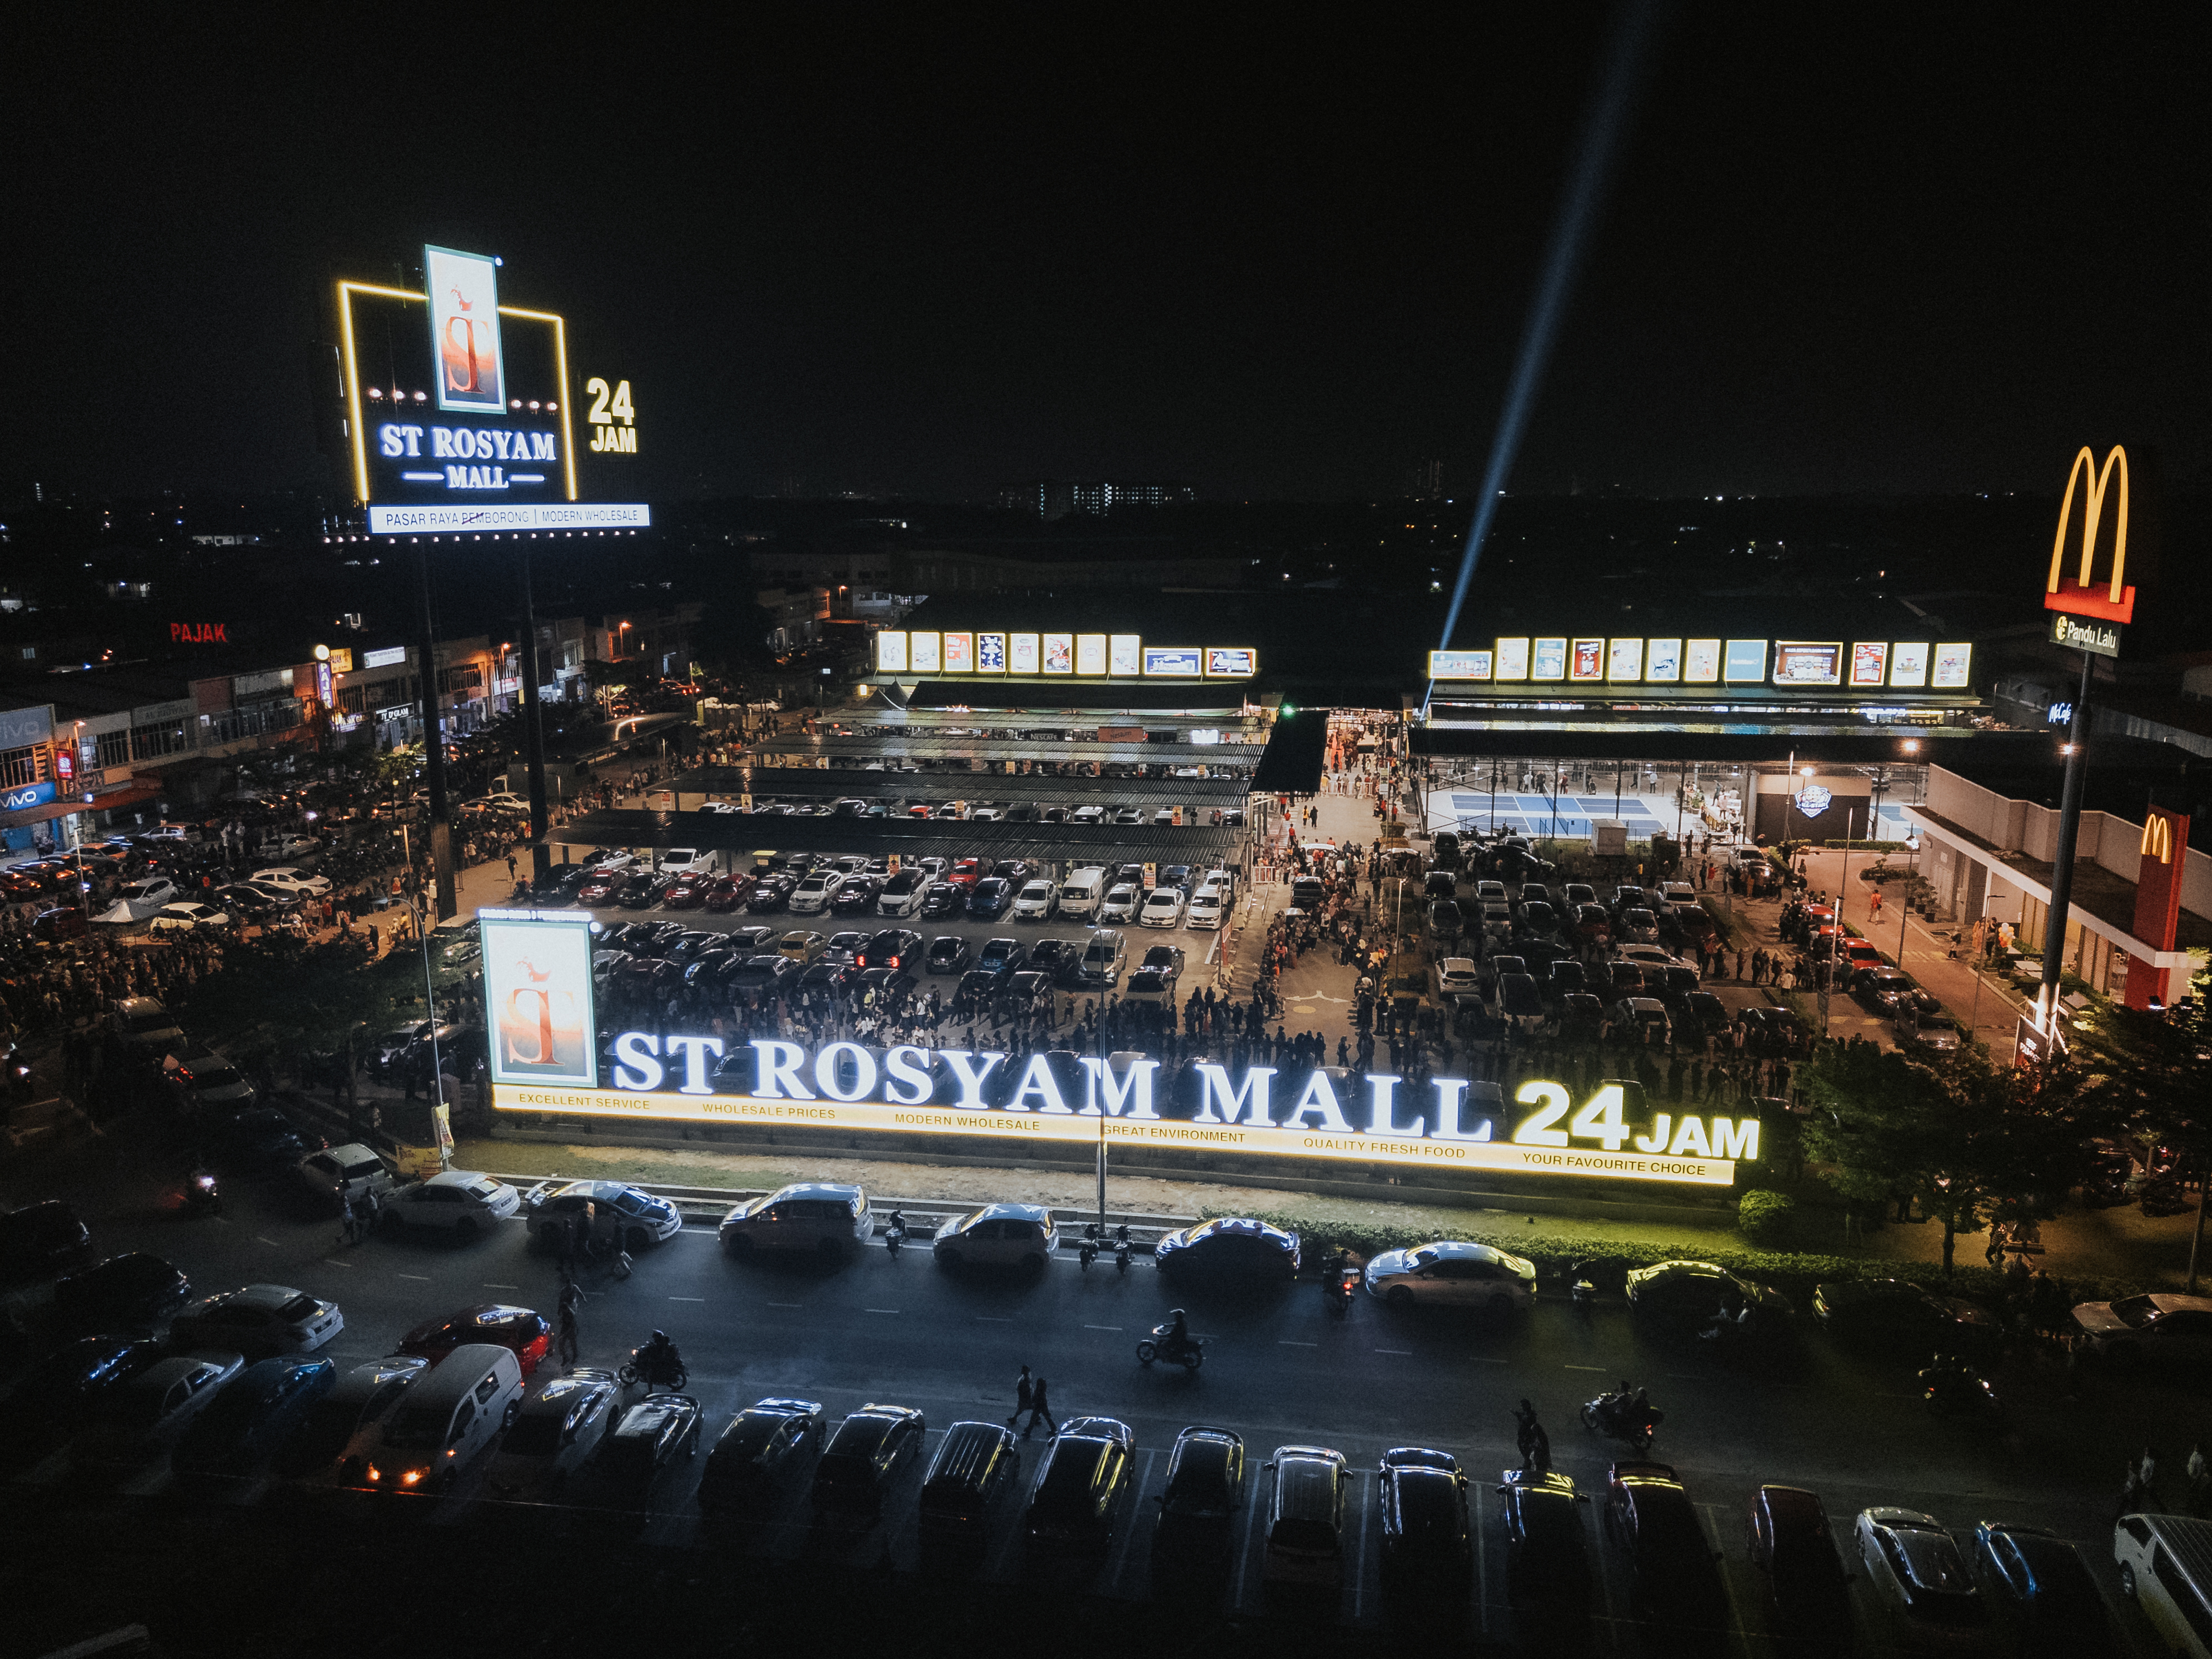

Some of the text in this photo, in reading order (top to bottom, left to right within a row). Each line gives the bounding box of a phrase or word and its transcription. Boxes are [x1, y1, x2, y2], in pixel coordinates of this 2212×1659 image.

[587, 377, 635, 425] 24
[381, 425, 556, 460] ST ROSYAM
[590, 426, 637, 453] JAM
[446, 466, 509, 489] MALL
[386, 509, 637, 526] PASAR RAYA PEMBORONG MODERN WHOLESALE
[171, 622, 227, 643] PAJAK
[2067, 621, 2116, 649] Pandu Lalu
[320, 662, 332, 709] PAJAK
[2049, 703, 2071, 725] McCafé
[0, 790, 37, 808] vivo
[519, 1093, 650, 1109] EXCELLENT SERVICE
[614, 1032, 1761, 1160] ST ROSYAM MALL 24 JAM
[703, 1103, 835, 1119] WHOLESALE PRICES
[895, 1114, 1040, 1130] MODERN WHOLESALE
[1104, 1125, 1246, 1143] GREAT ENVIRONMENT
[1304, 1138, 1466, 1159] QUALITY FRESH FOOD
[1523, 1153, 1706, 1176] YOUR FAVOURITE CHOICE
